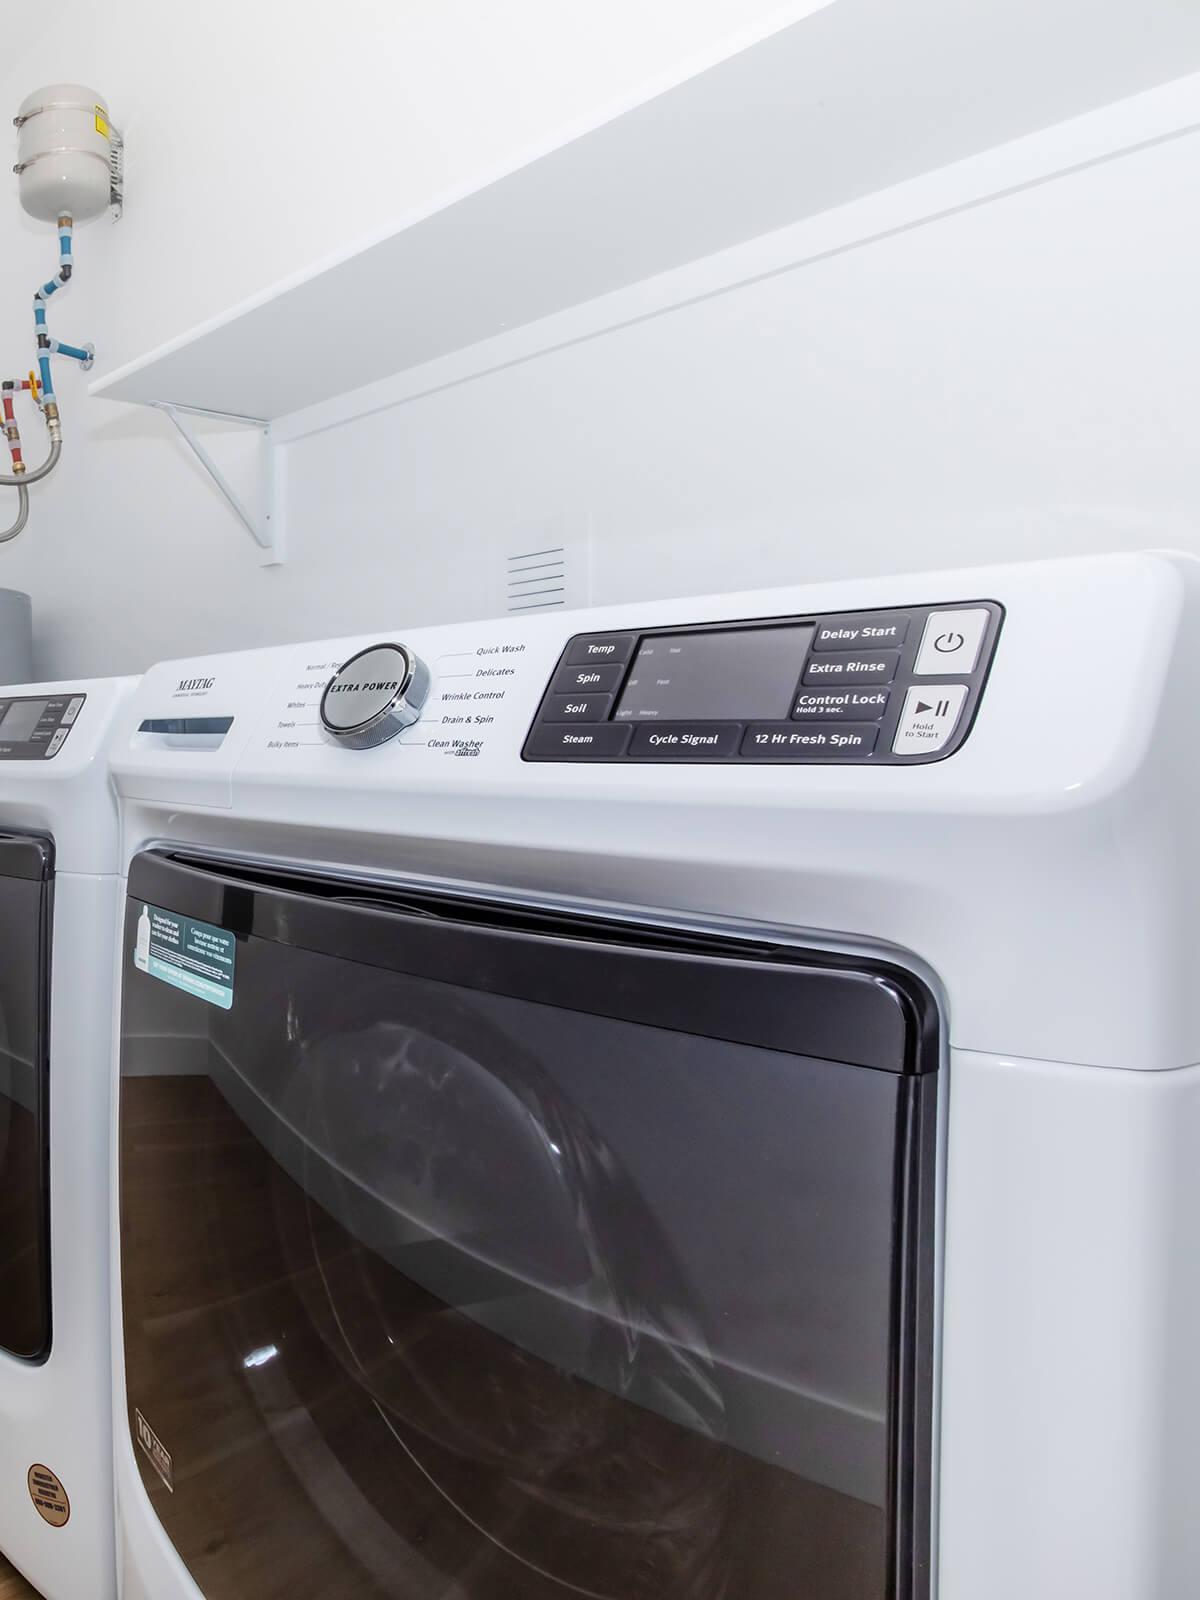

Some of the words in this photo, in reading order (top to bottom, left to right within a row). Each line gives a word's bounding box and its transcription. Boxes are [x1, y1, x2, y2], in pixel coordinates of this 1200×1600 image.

[820, 628, 859, 640] Delay
[861, 626, 897, 637] Start
[476, 646, 499, 656] Quick
[502, 644, 526, 653] Wash
[587, 645, 615, 654] Temp
[476, 668, 516, 677] Delicates
[809, 663, 843, 673] Extra
[846, 661, 886, 672] Rinse
[176, 677, 216, 691] MAYTAG
[576, 673, 601, 684] Spin
[330, 684, 360, 693] EXTRA
[362, 681, 398, 691] POWER
[441, 692, 472, 701] Wrinkle
[473, 690, 506, 700] Control
[799, 694, 849, 705] Control
[852, 694, 886, 704] Lock
[564, 703, 587, 714] Soil
[441, 715, 464, 724] Drain
[465, 715, 472, 724] &
[474, 715, 494, 725] Spin
[427, 739, 450, 748] Clean
[451, 739, 484, 748] Washer
[562, 735, 593, 744] Steam
[649, 734, 678, 745] Cycle
[680, 734, 718, 745] Signal
[754, 734, 768, 744] 12
[771, 735, 787, 744] Hr
[789, 734, 826, 745] Fresh
[829, 734, 862, 746] Spin
